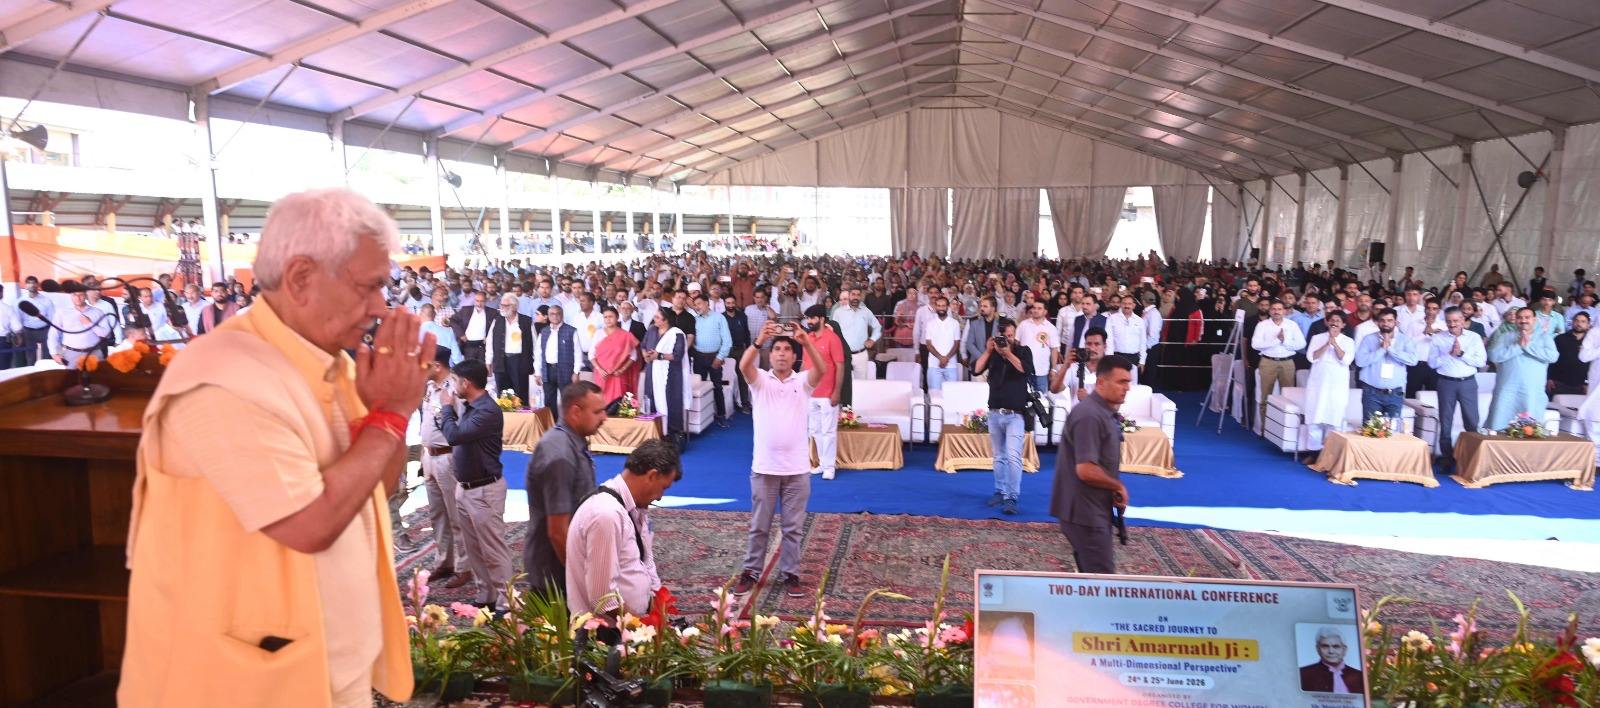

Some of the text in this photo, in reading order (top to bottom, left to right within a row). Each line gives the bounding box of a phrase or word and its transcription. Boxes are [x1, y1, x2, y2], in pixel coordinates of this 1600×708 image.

[1048, 584, 1279, 604] TWO-DAY INTERNATIONAL CONFERENCE
[1133, 624, 1165, 633] SACRED
[1168, 625, 1204, 635] JOURNEY
[1207, 626, 1218, 635] TO
[1081, 636, 1121, 652] Shri
[1125, 638, 1221, 657] Amarnath
[1224, 642, 1240, 660] Ji
[1091, 658, 1097, 667] A
[1100, 658, 1181, 671] Multi-Dimensional
[1167, 677, 1184, 685] June
